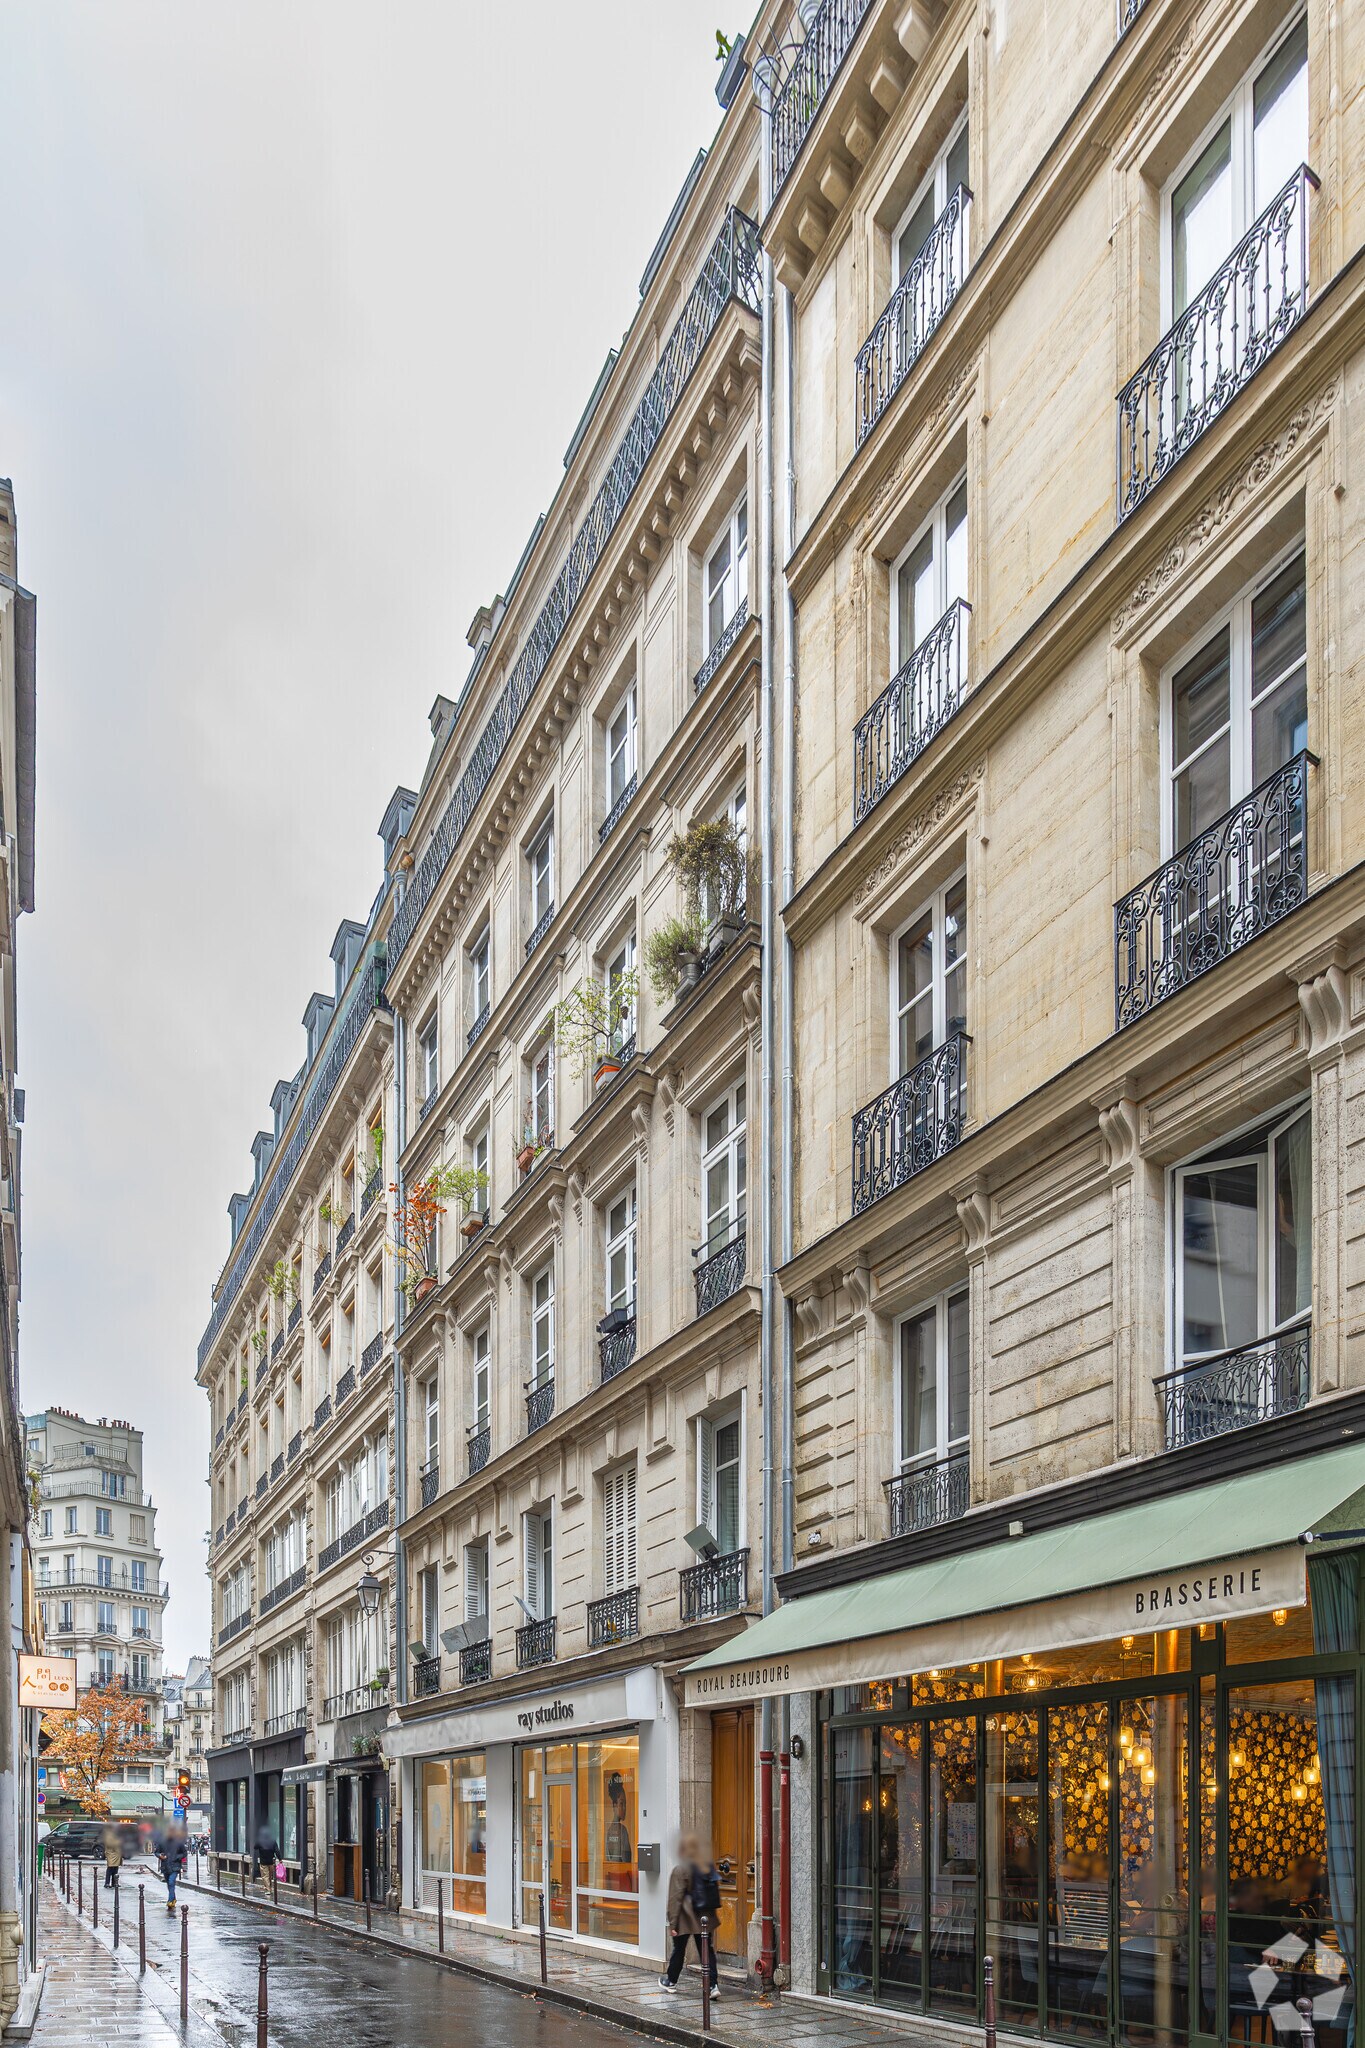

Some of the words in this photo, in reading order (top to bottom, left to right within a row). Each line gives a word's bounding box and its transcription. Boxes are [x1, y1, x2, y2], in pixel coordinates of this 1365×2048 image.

[1135, 1568, 1262, 1614] BRASSERIE
[697, 1675, 725, 1694] ROYAL
[730, 1664, 790, 1689] BEAUBOURG
[517, 1711, 534, 1732] ray
[535, 1700, 574, 1724] studios
